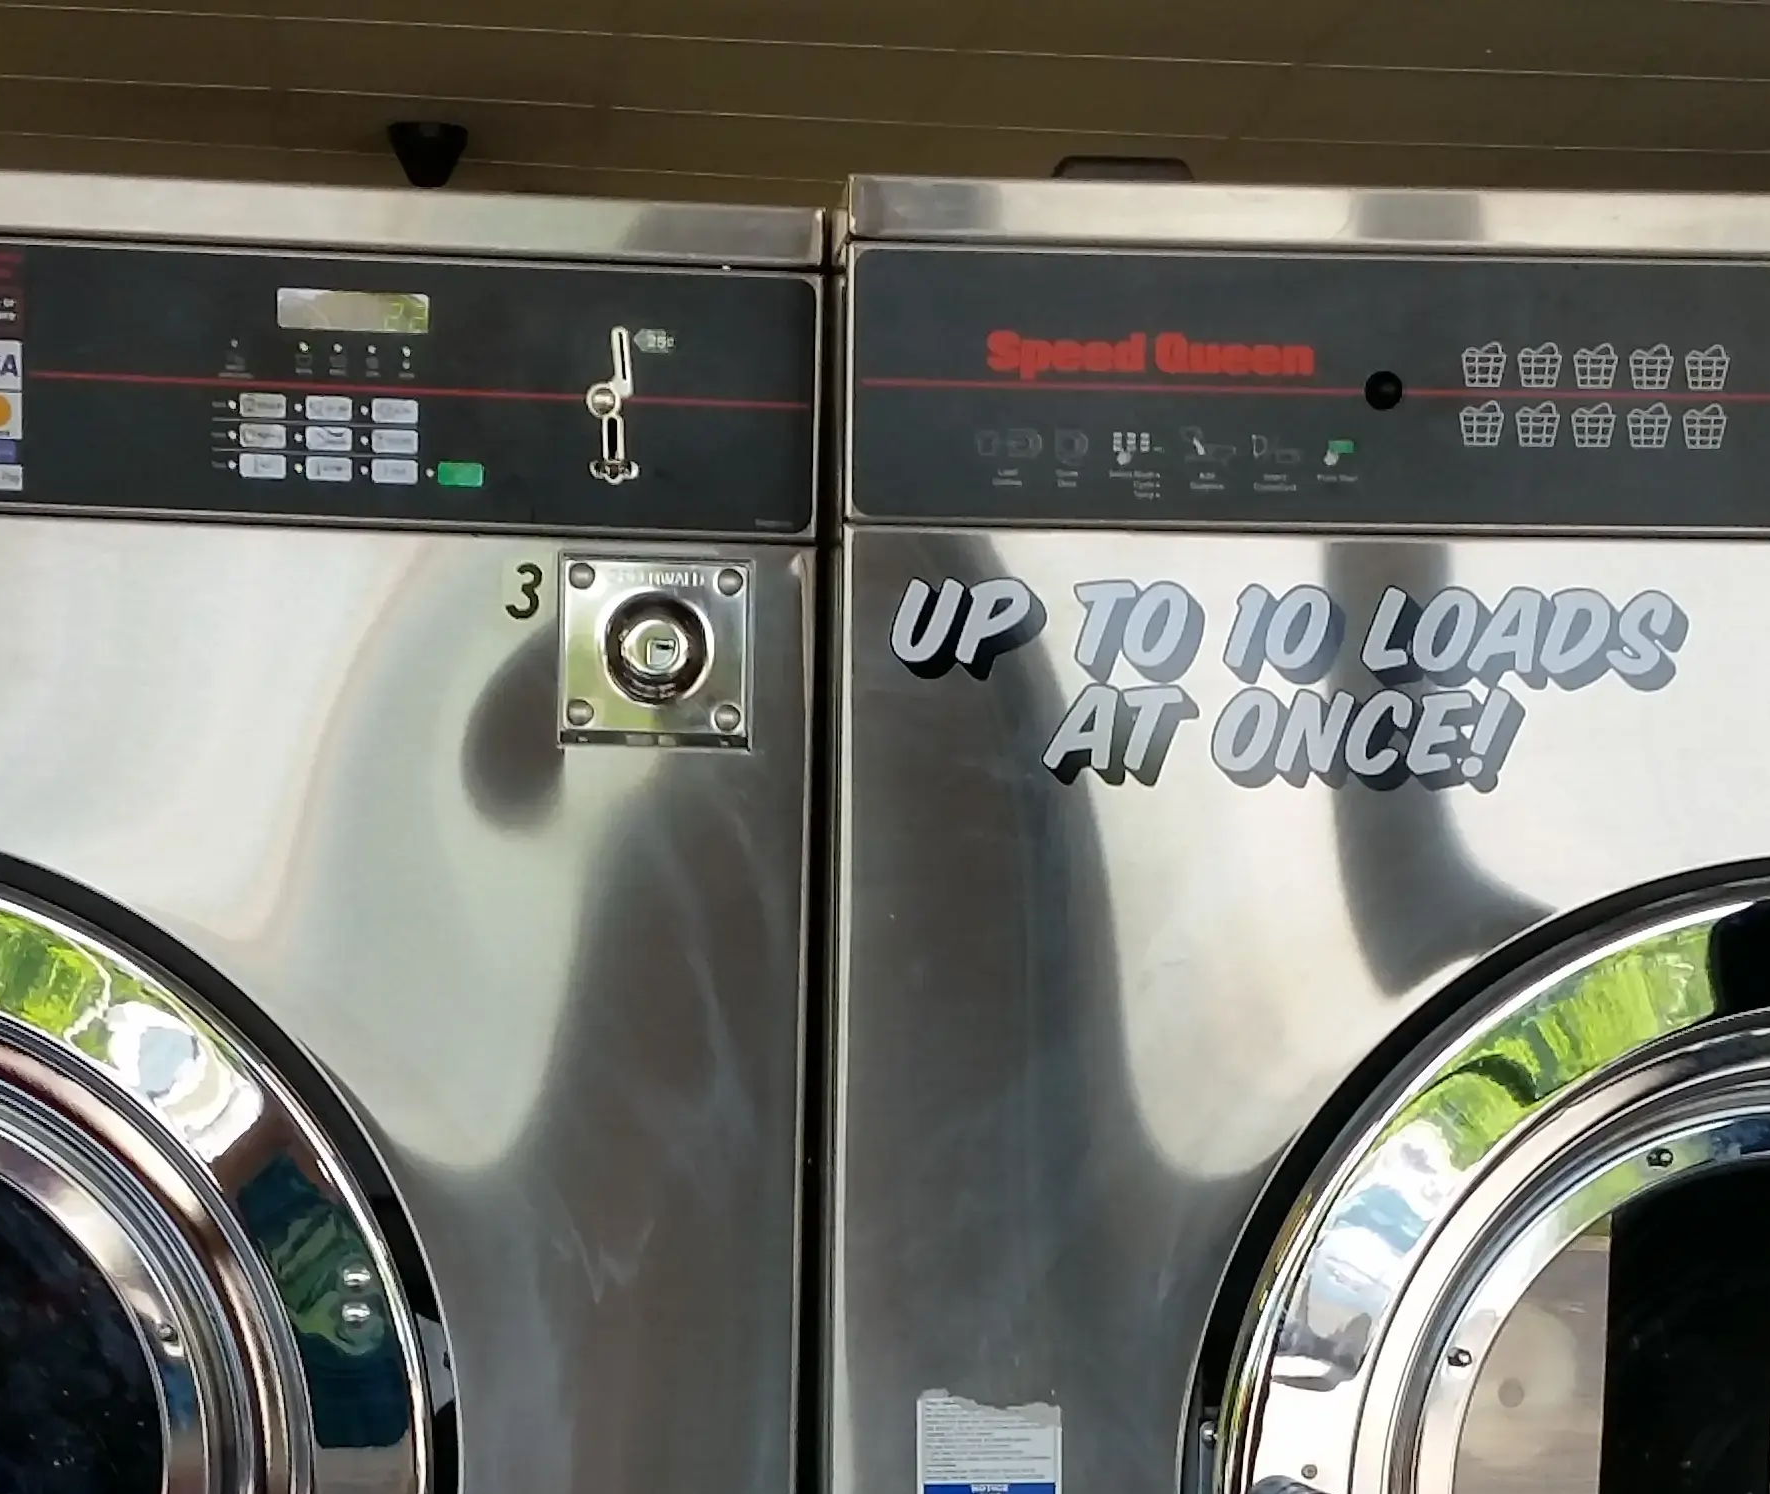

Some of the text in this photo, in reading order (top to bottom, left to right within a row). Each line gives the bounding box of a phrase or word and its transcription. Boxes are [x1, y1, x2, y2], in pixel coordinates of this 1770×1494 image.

[986, 329, 1316, 382] Speed Queen
[504, 562, 544, 620] 3
[889, 576, 1690, 693] UP TO 10 LOADS
[1042, 684, 1526, 795] AT ONCE!
